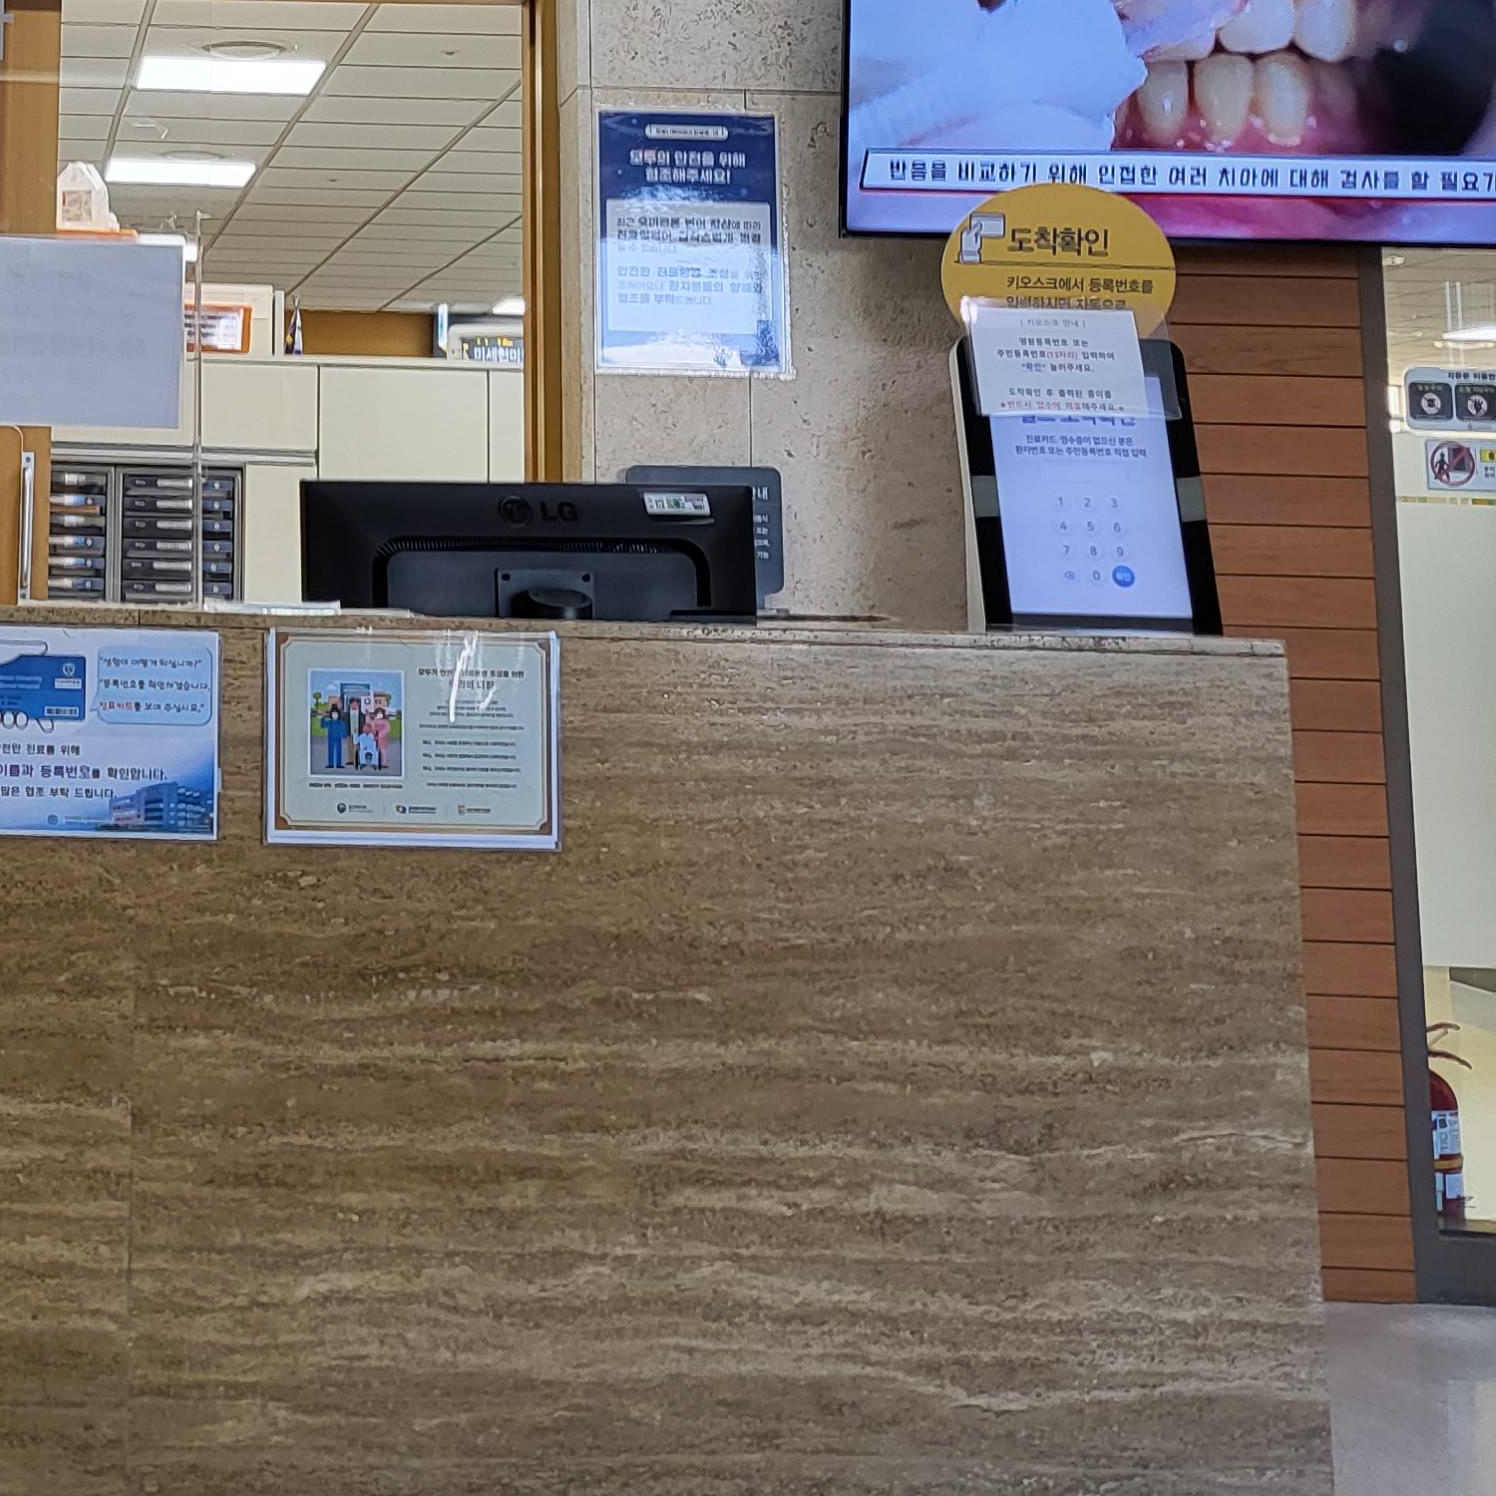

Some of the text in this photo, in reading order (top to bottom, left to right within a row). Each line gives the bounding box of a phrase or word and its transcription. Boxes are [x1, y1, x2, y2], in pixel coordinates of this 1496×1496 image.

[719, 152, 746, 168] 위해
[958, 160, 1037, 183] 비교하기
[1048, 162, 1088, 184] 위해
[1098, 164, 1157, 185] 인접한
[1168, 166, 1205, 187] 여러
[1218, 167, 1279, 188] 치아에
[1289, 168, 1329, 189] 대해
[1340, 169, 1400, 191] 검사를
[1411, 171, 1429, 191] 할
[1007, 227, 1109, 257] 도착확인
[1006, 276, 1153, 294] 키오스크에서 등록번호를
[1058, 497, 1118, 509] 1 2 3
[540, 502, 578, 523] LG
[1060, 521, 1121, 533] 4 5 6
[1063, 545, 1124, 557] 7 8 9
[1093, 571, 1100, 581] 0
[26, 744, 55, 755] 진료를
[60, 745, 80, 756] 위해
[40, 764, 100, 780] 등록번호를
[1, 785, 20, 797] 많은
[25, 786, 46, 798] 협조
[49, 787, 69, 799] 부탁
[74, 787, 117, 799] 드립니다.
